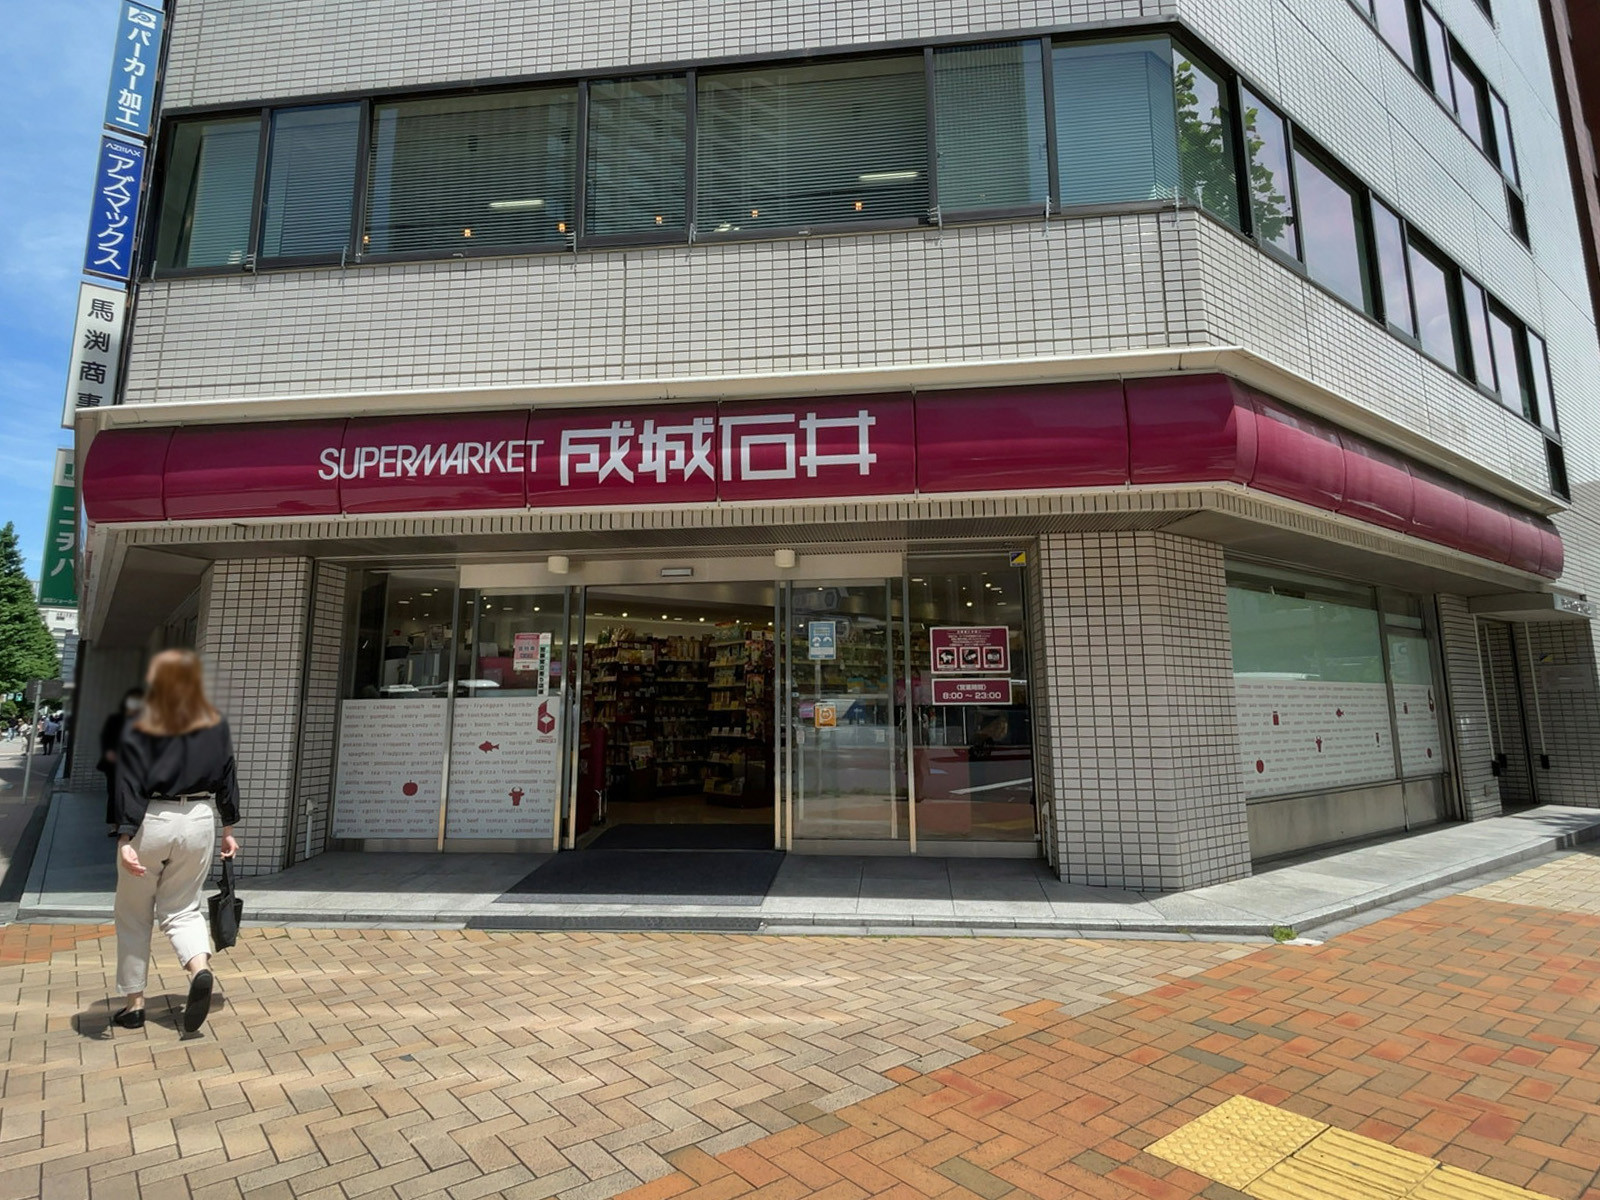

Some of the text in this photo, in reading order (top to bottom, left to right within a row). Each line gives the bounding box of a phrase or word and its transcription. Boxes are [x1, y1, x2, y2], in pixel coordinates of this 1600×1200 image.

[115, 27, 152, 128] パーカー加工
[94, 153, 136, 271] アズマックス
[318, 439, 544, 481] SUPERMARKET
[559, 409, 877, 487] 成城石井
[943, 691, 964, 699] 8:00
[975, 690, 1001, 699] 23:00
